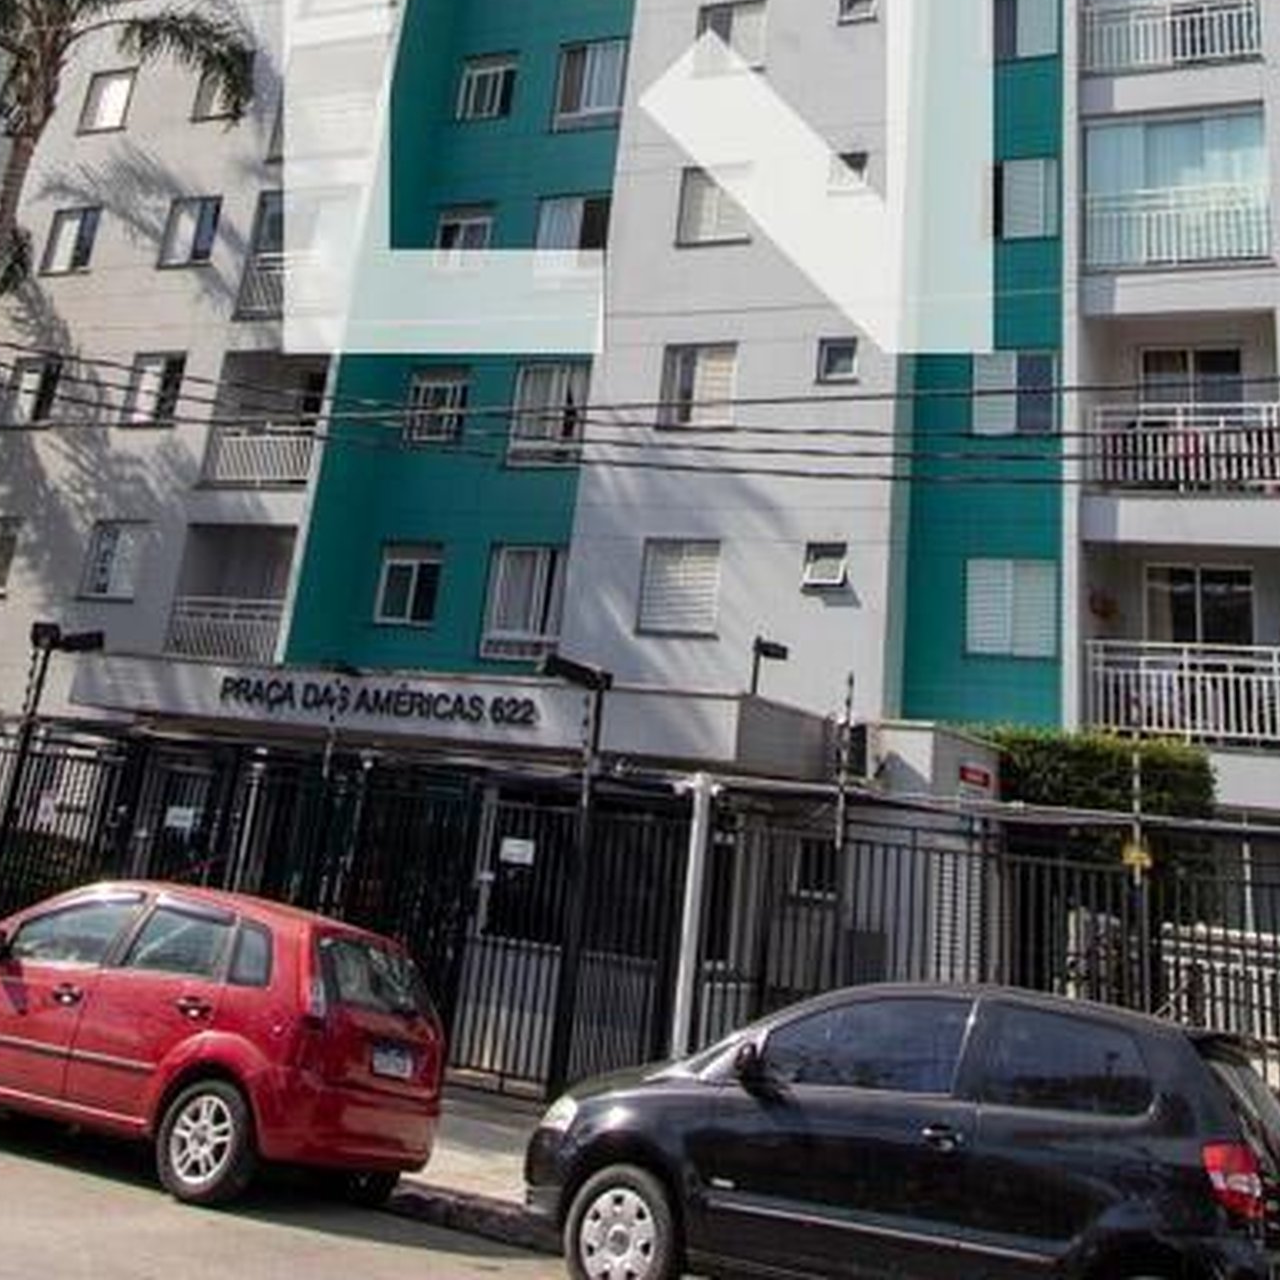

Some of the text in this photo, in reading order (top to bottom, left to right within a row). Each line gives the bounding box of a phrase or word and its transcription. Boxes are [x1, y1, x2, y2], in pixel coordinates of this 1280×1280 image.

[221, 676, 538, 724] PRAÇA DAS AMÉRICAS 622
